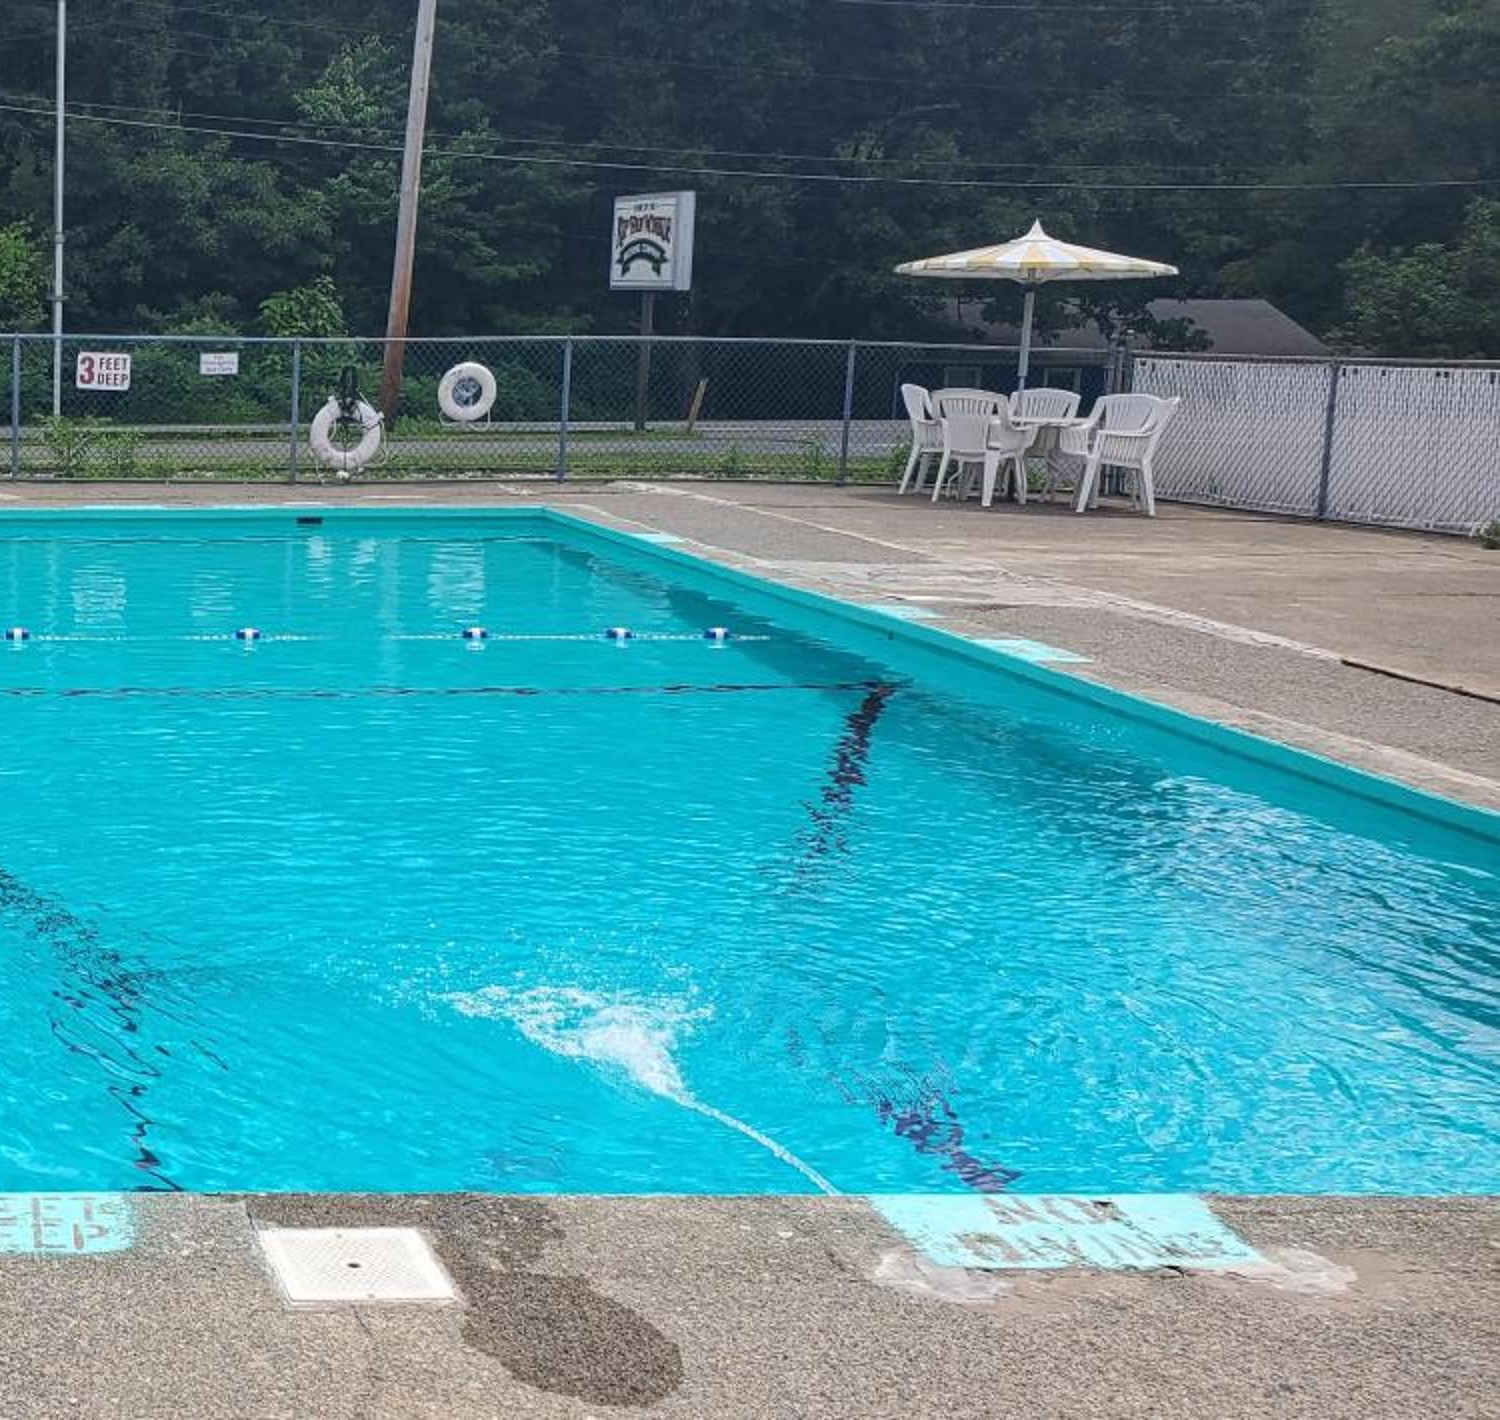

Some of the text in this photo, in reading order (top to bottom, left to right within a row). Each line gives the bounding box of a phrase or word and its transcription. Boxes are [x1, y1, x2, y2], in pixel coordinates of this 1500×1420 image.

[80, 356, 128, 385] 3 FEET
[97, 373, 128, 387] DEEP
